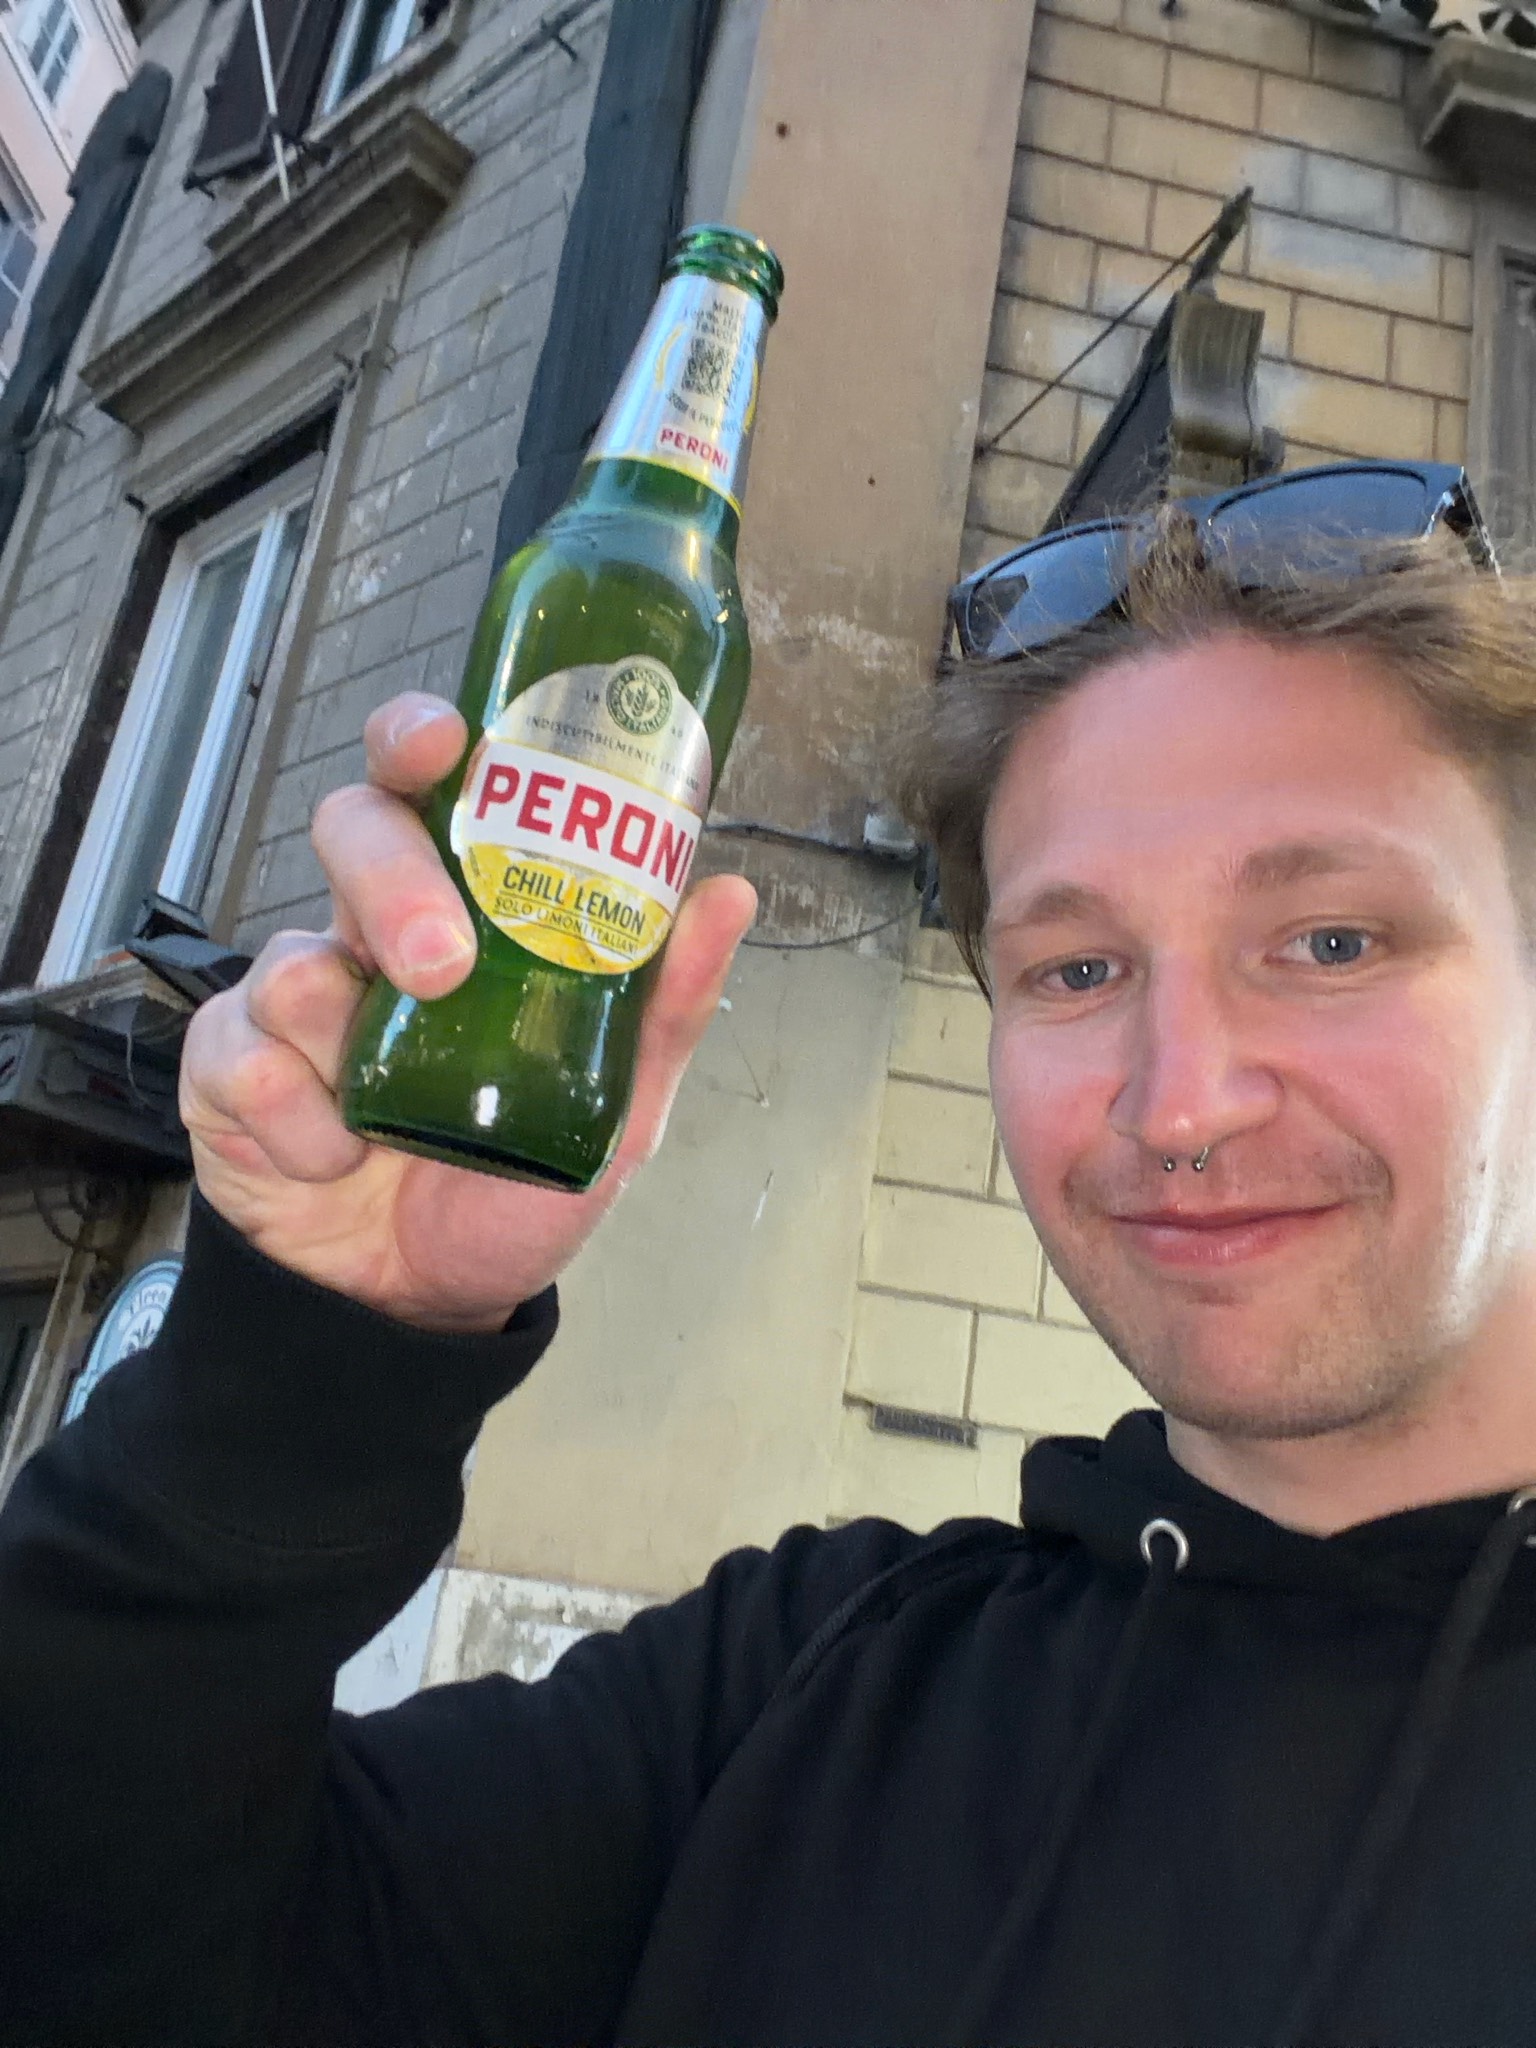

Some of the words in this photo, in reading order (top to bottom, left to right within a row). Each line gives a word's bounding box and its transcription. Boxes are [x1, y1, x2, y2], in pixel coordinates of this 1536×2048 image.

[660, 427, 729, 475] PERONI
[474, 762, 694, 894] PERONI
[494, 896, 533, 916] SOLO
[537, 907, 589, 935] LIMONI
[503, 865, 565, 906] CHILL
[574, 885, 646, 937] LEMON
